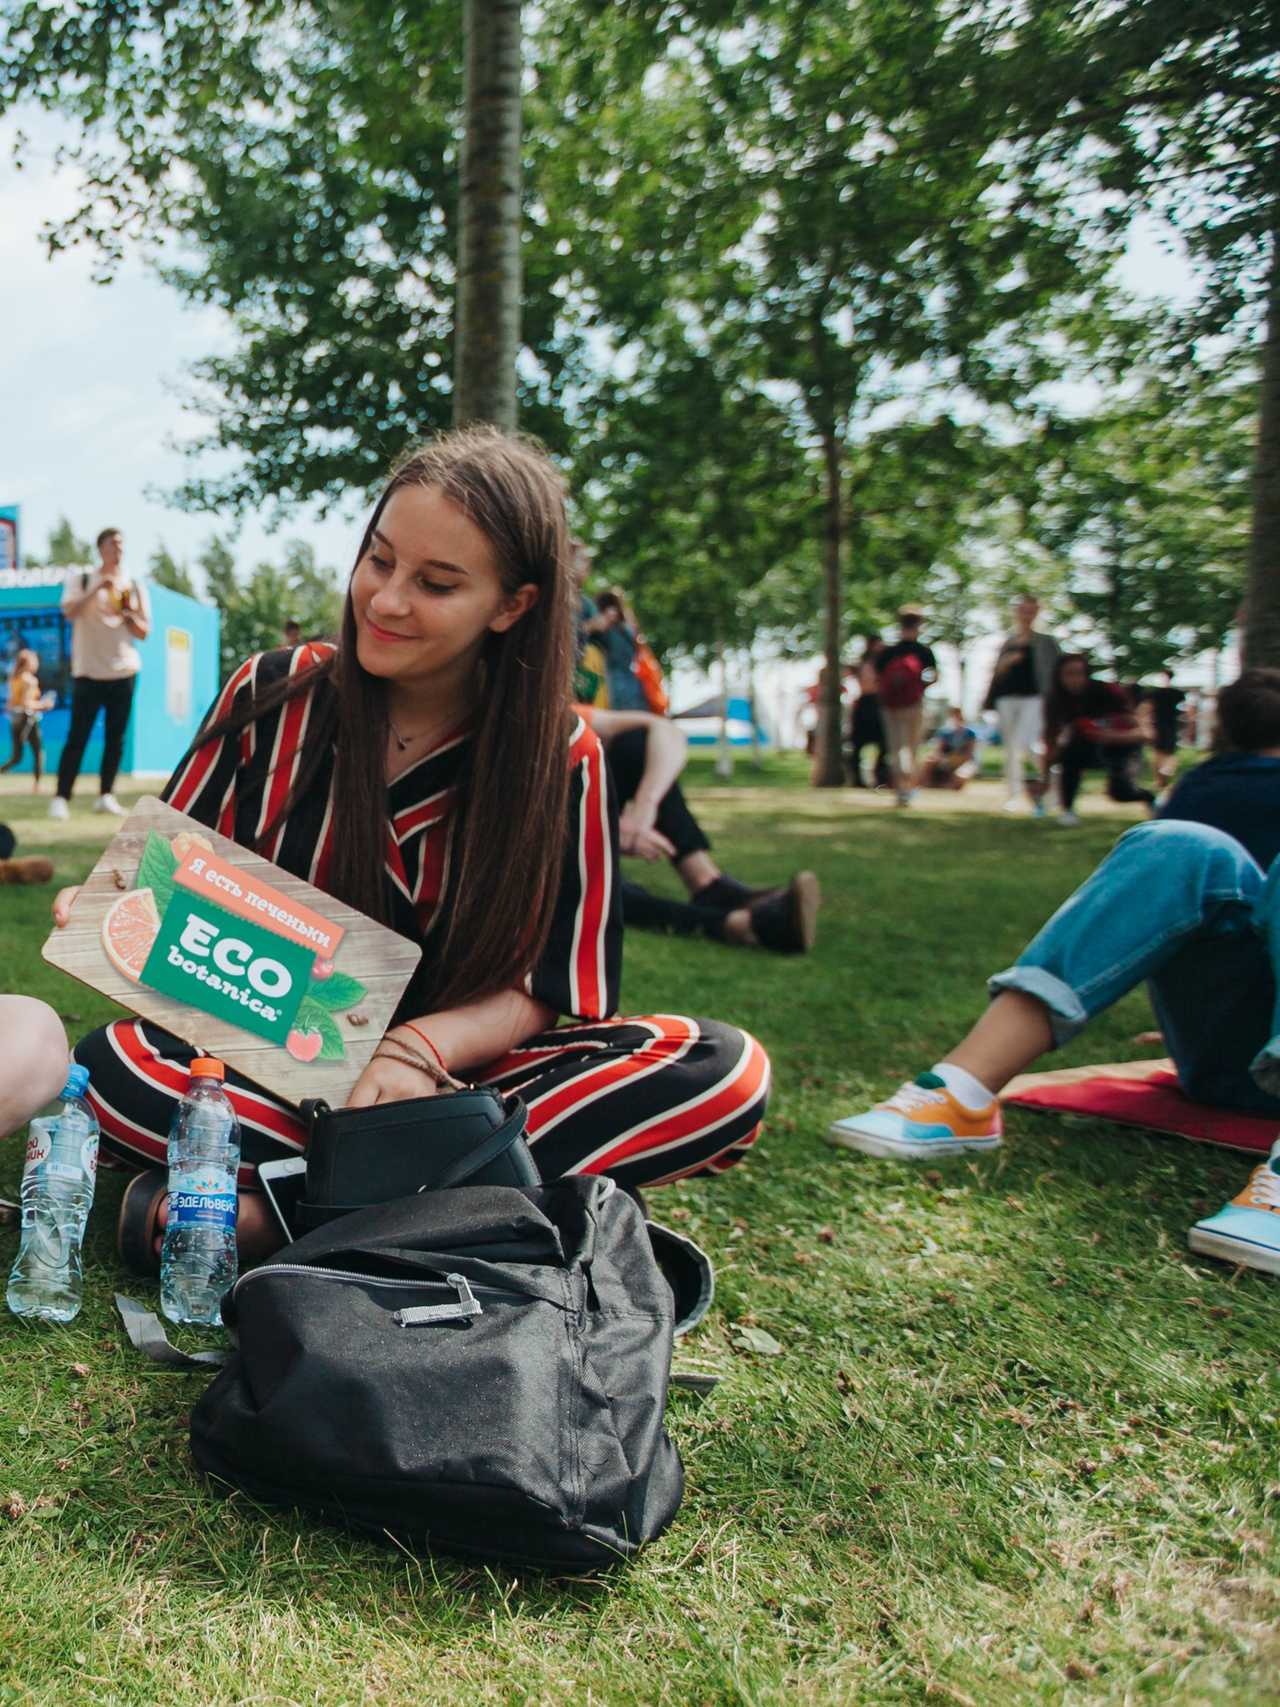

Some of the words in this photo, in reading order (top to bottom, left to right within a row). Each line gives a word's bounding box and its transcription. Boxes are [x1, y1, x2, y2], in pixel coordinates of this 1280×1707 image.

[188, 857, 207, 876] Я
[205, 868, 243, 898] есть
[243, 890, 331, 949] печеньки
[166, 945, 278, 1023] botanica
[178, 912, 293, 999] ECO
[178, 1196, 236, 1214] ЭДЕЛЬВЕЙС
